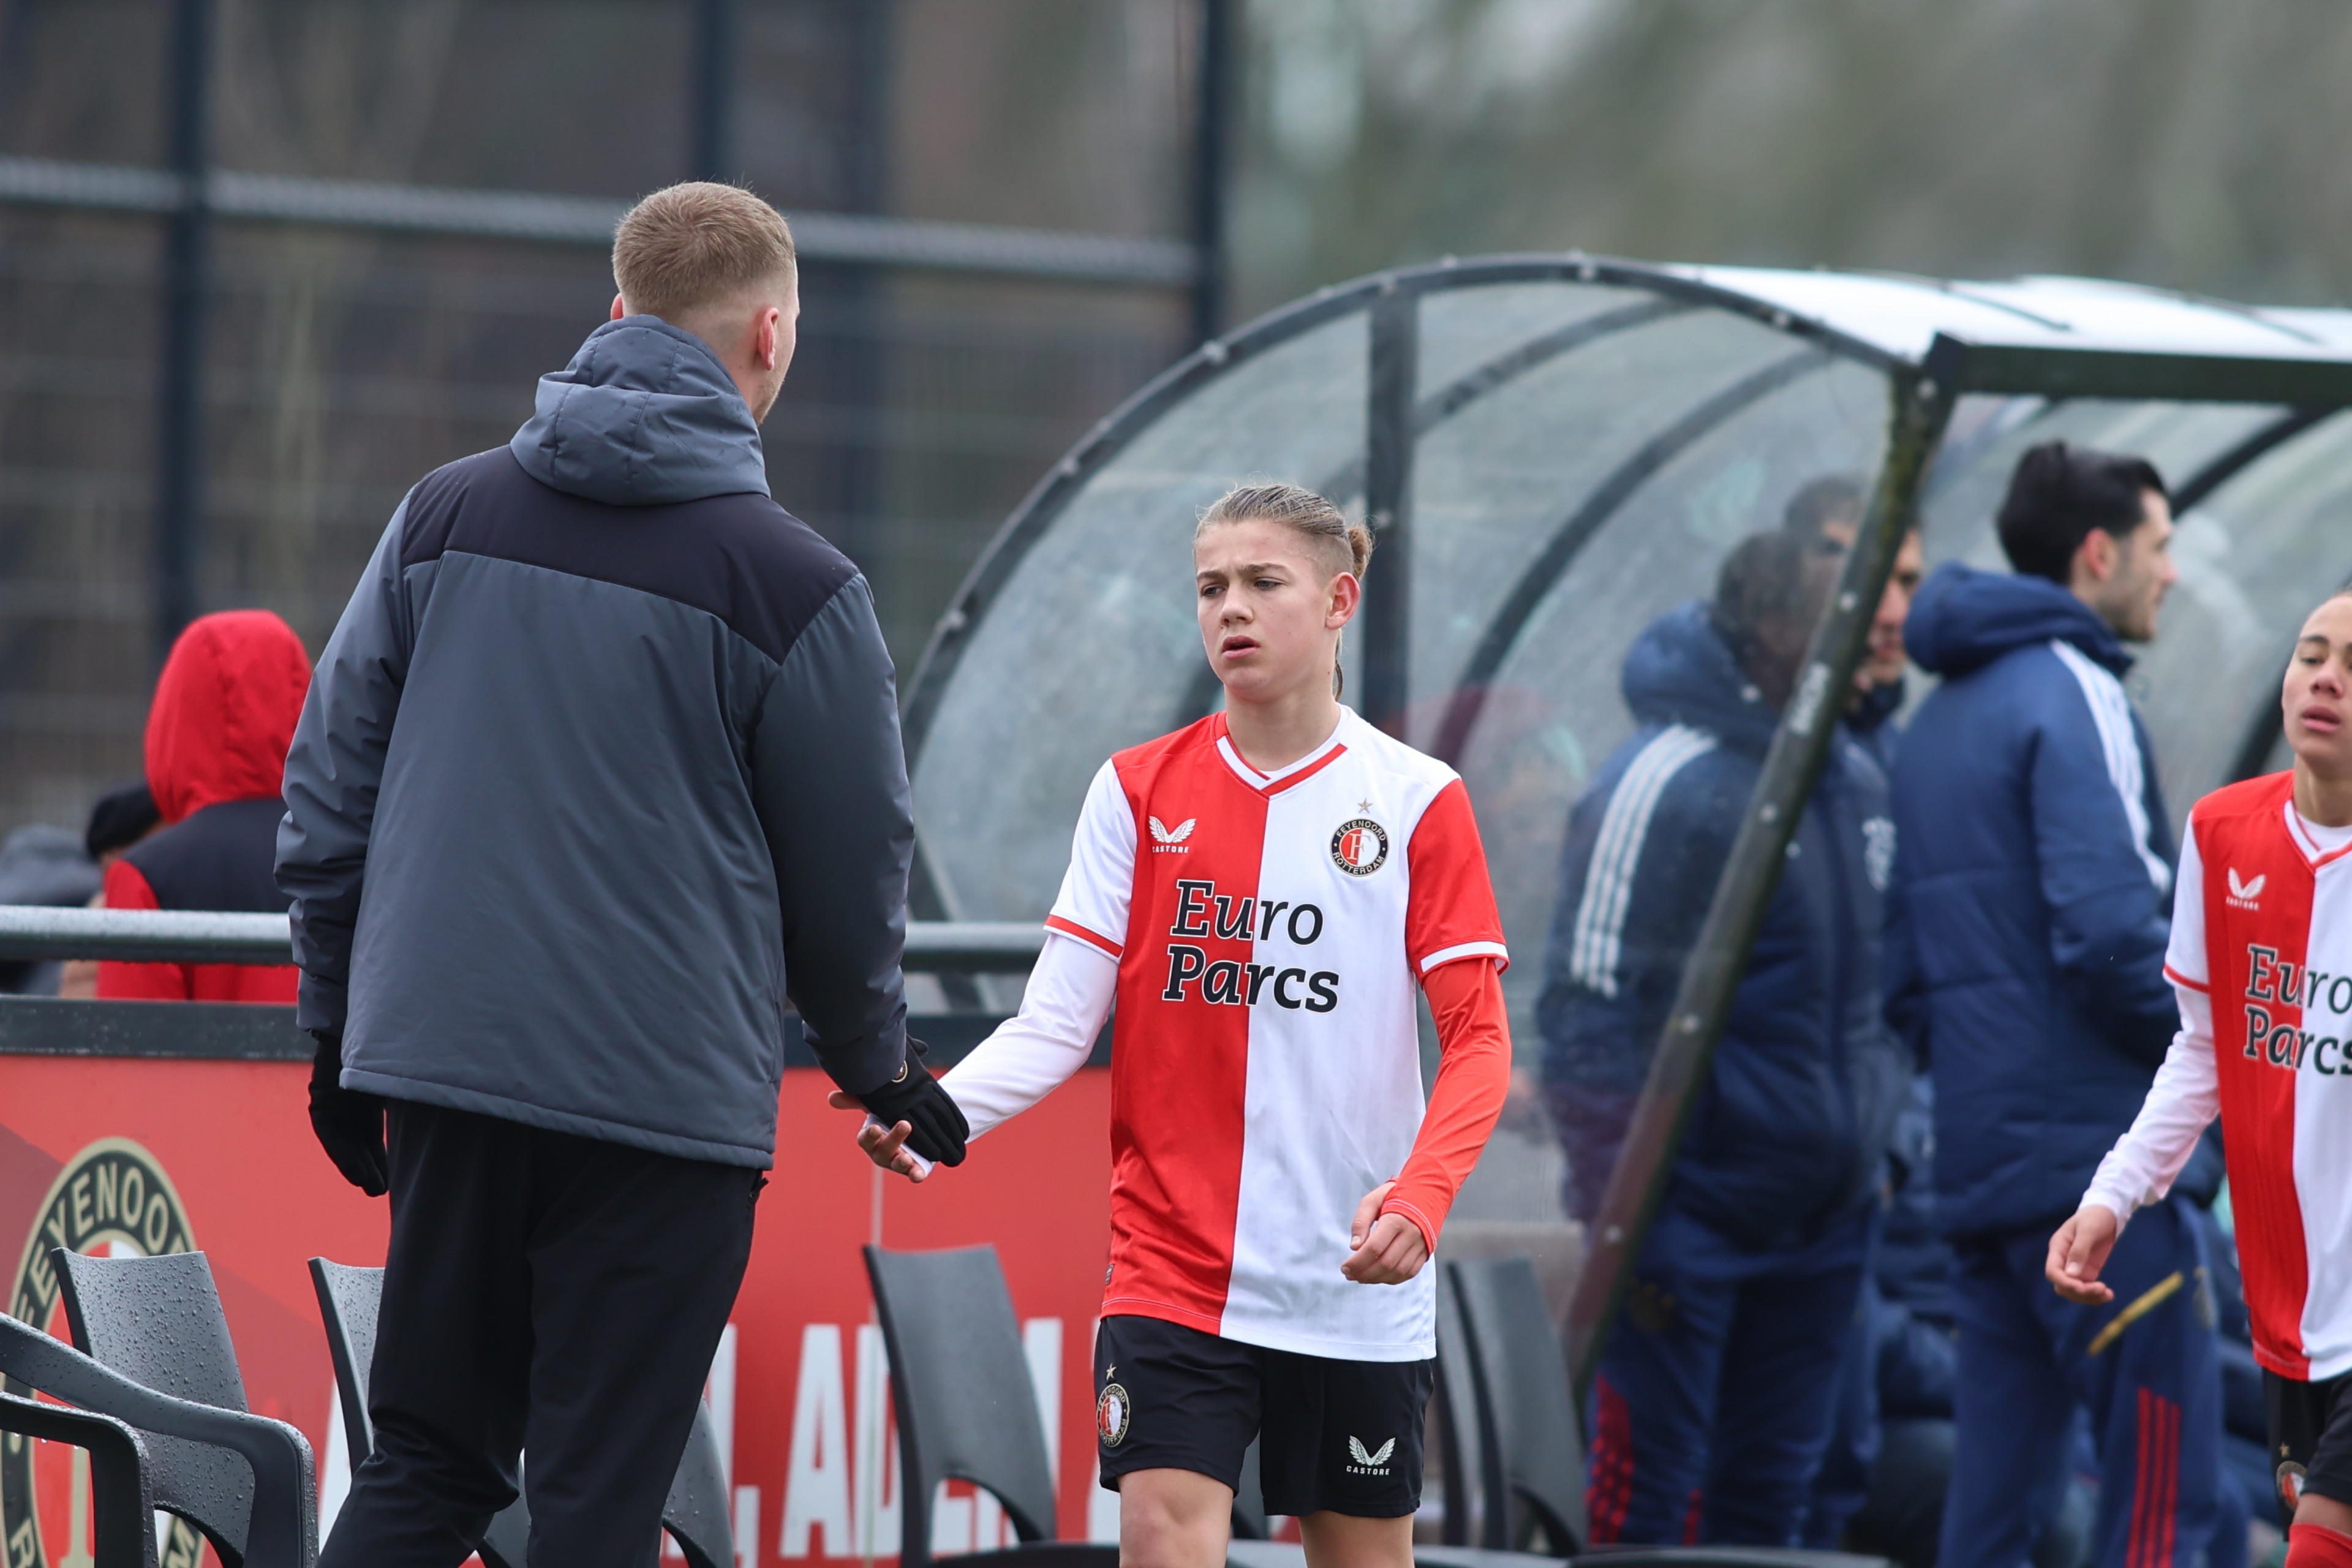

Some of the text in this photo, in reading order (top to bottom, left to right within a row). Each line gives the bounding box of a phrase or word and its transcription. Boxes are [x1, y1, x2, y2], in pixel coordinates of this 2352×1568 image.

[1152, 845, 1190, 854] CASTORE
[1336, 820, 1386, 842] FEYENOORD
[1333, 851, 1385, 875] ROTTERDAM
[1169, 878, 1324, 946] Euro
[1161, 943, 1340, 1014] Parcs
[2245, 943, 2352, 1015] Euro
[17, 1162, 186, 1327] EYENOO
[1346, 1465, 1390, 1476] CASTORE
